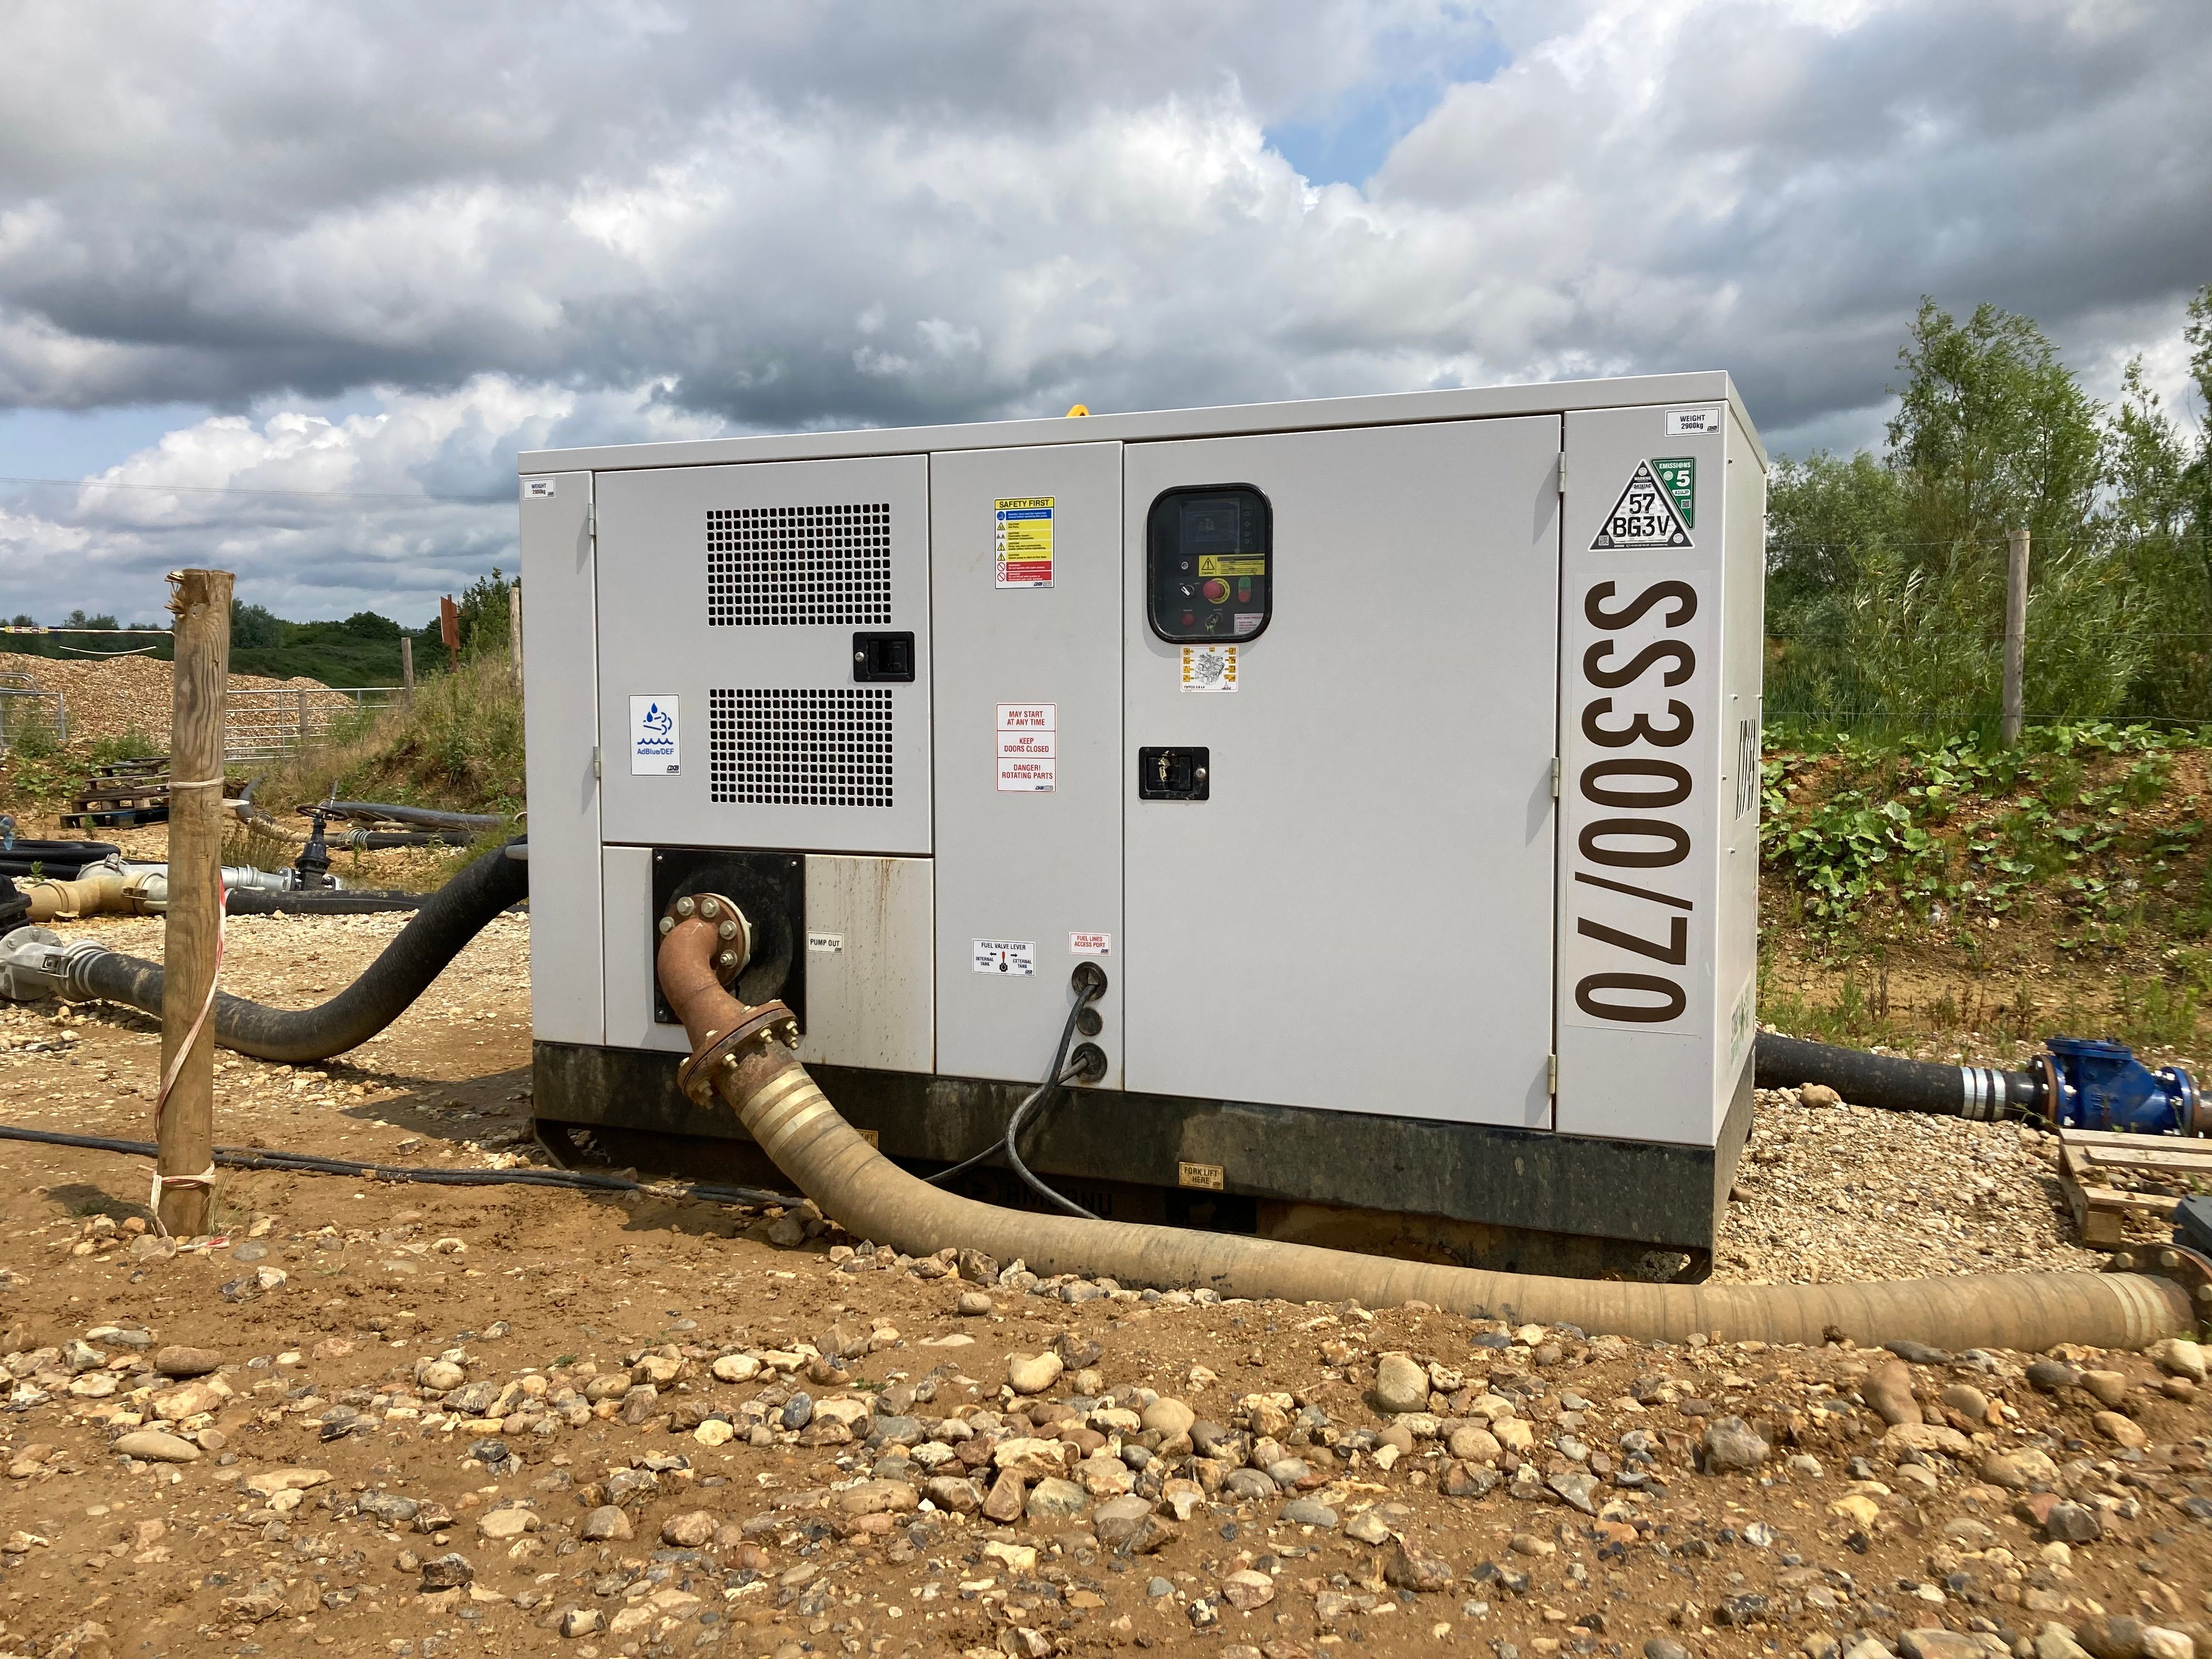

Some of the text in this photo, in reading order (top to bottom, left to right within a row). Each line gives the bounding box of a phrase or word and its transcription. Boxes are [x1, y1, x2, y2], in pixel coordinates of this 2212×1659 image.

[1676, 470, 1690, 487] 5
[1629, 493, 1655, 514] 57
[1613, 515, 1670, 537] BG3V
[1575, 580, 1697, 1024] SS300/70
[1184, 1166, 1218, 1177] FORK LIFT
[1192, 1176, 1210, 1184] HERE
